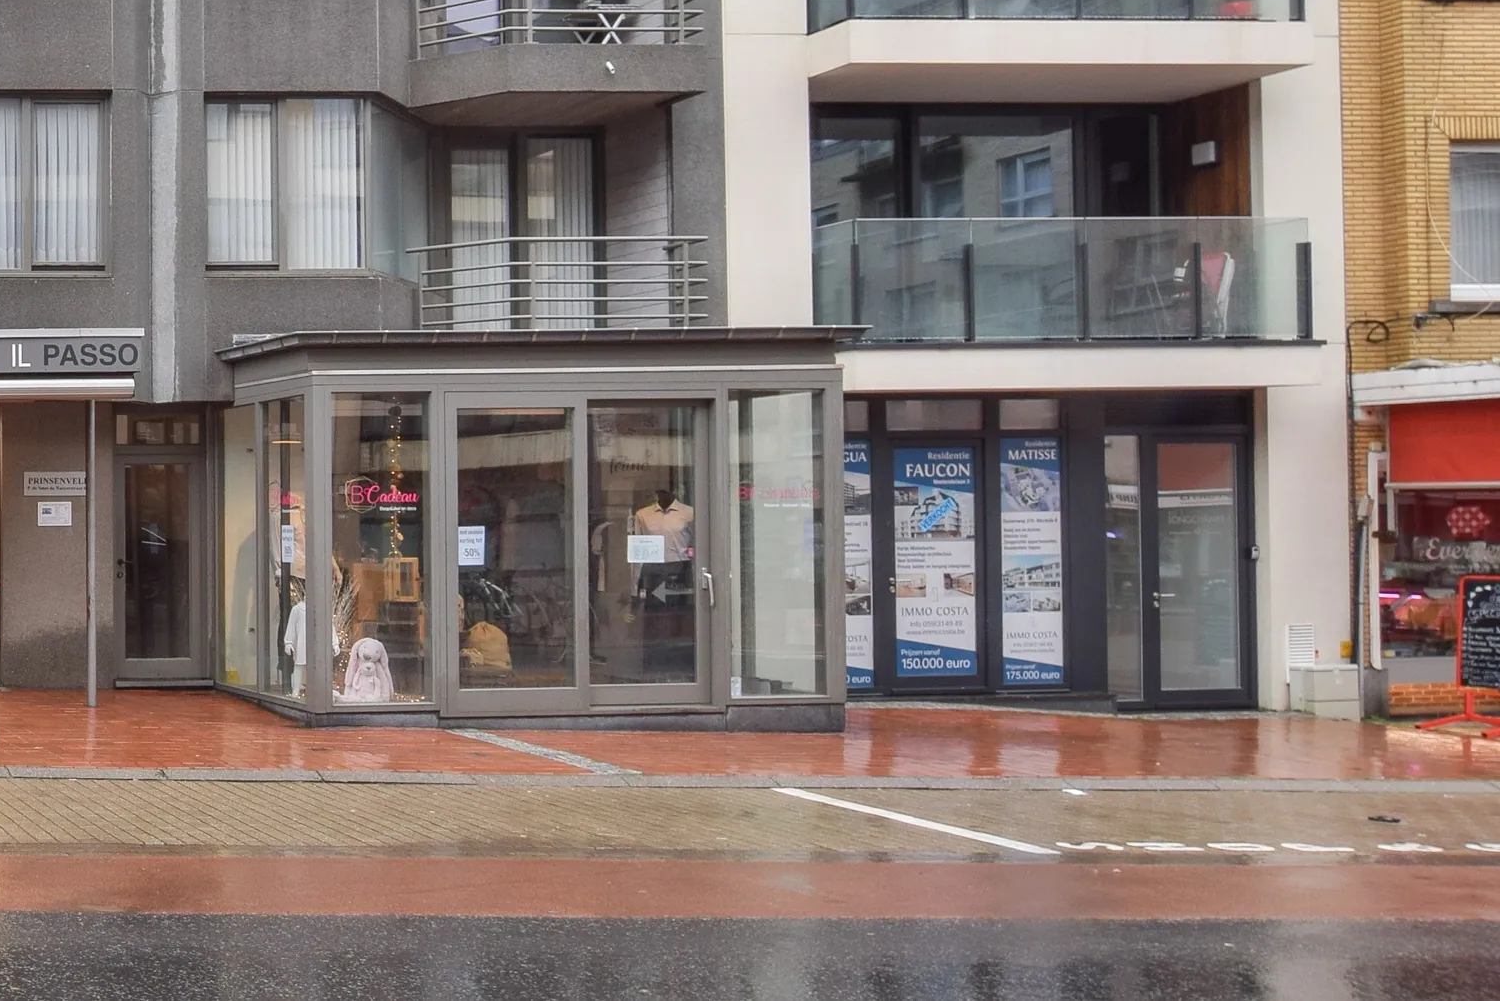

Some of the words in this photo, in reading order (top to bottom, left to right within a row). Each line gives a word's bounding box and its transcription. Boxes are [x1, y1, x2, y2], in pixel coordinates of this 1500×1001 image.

[11, 344, 31, 367] IL
[44, 343, 139, 366] PASSO
[844, 451, 867, 463] GUA
[927, 451, 970, 459] Residentie
[1008, 449, 1057, 460] MATISSE
[906, 463, 970, 477] FAUCON
[920, 499, 954, 529] VERKOCHT
[901, 607, 933, 617] IMMO
[936, 607, 969, 616] COSTA
[1006, 631, 1030, 639] IMMO
[1032, 631, 1058, 639] COSTA
[901, 649, 923, 657] Prijzen
[901, 658, 944, 669] 150.000
[946, 660, 971, 669] euro
[1006, 671, 1039, 679] 175.000
